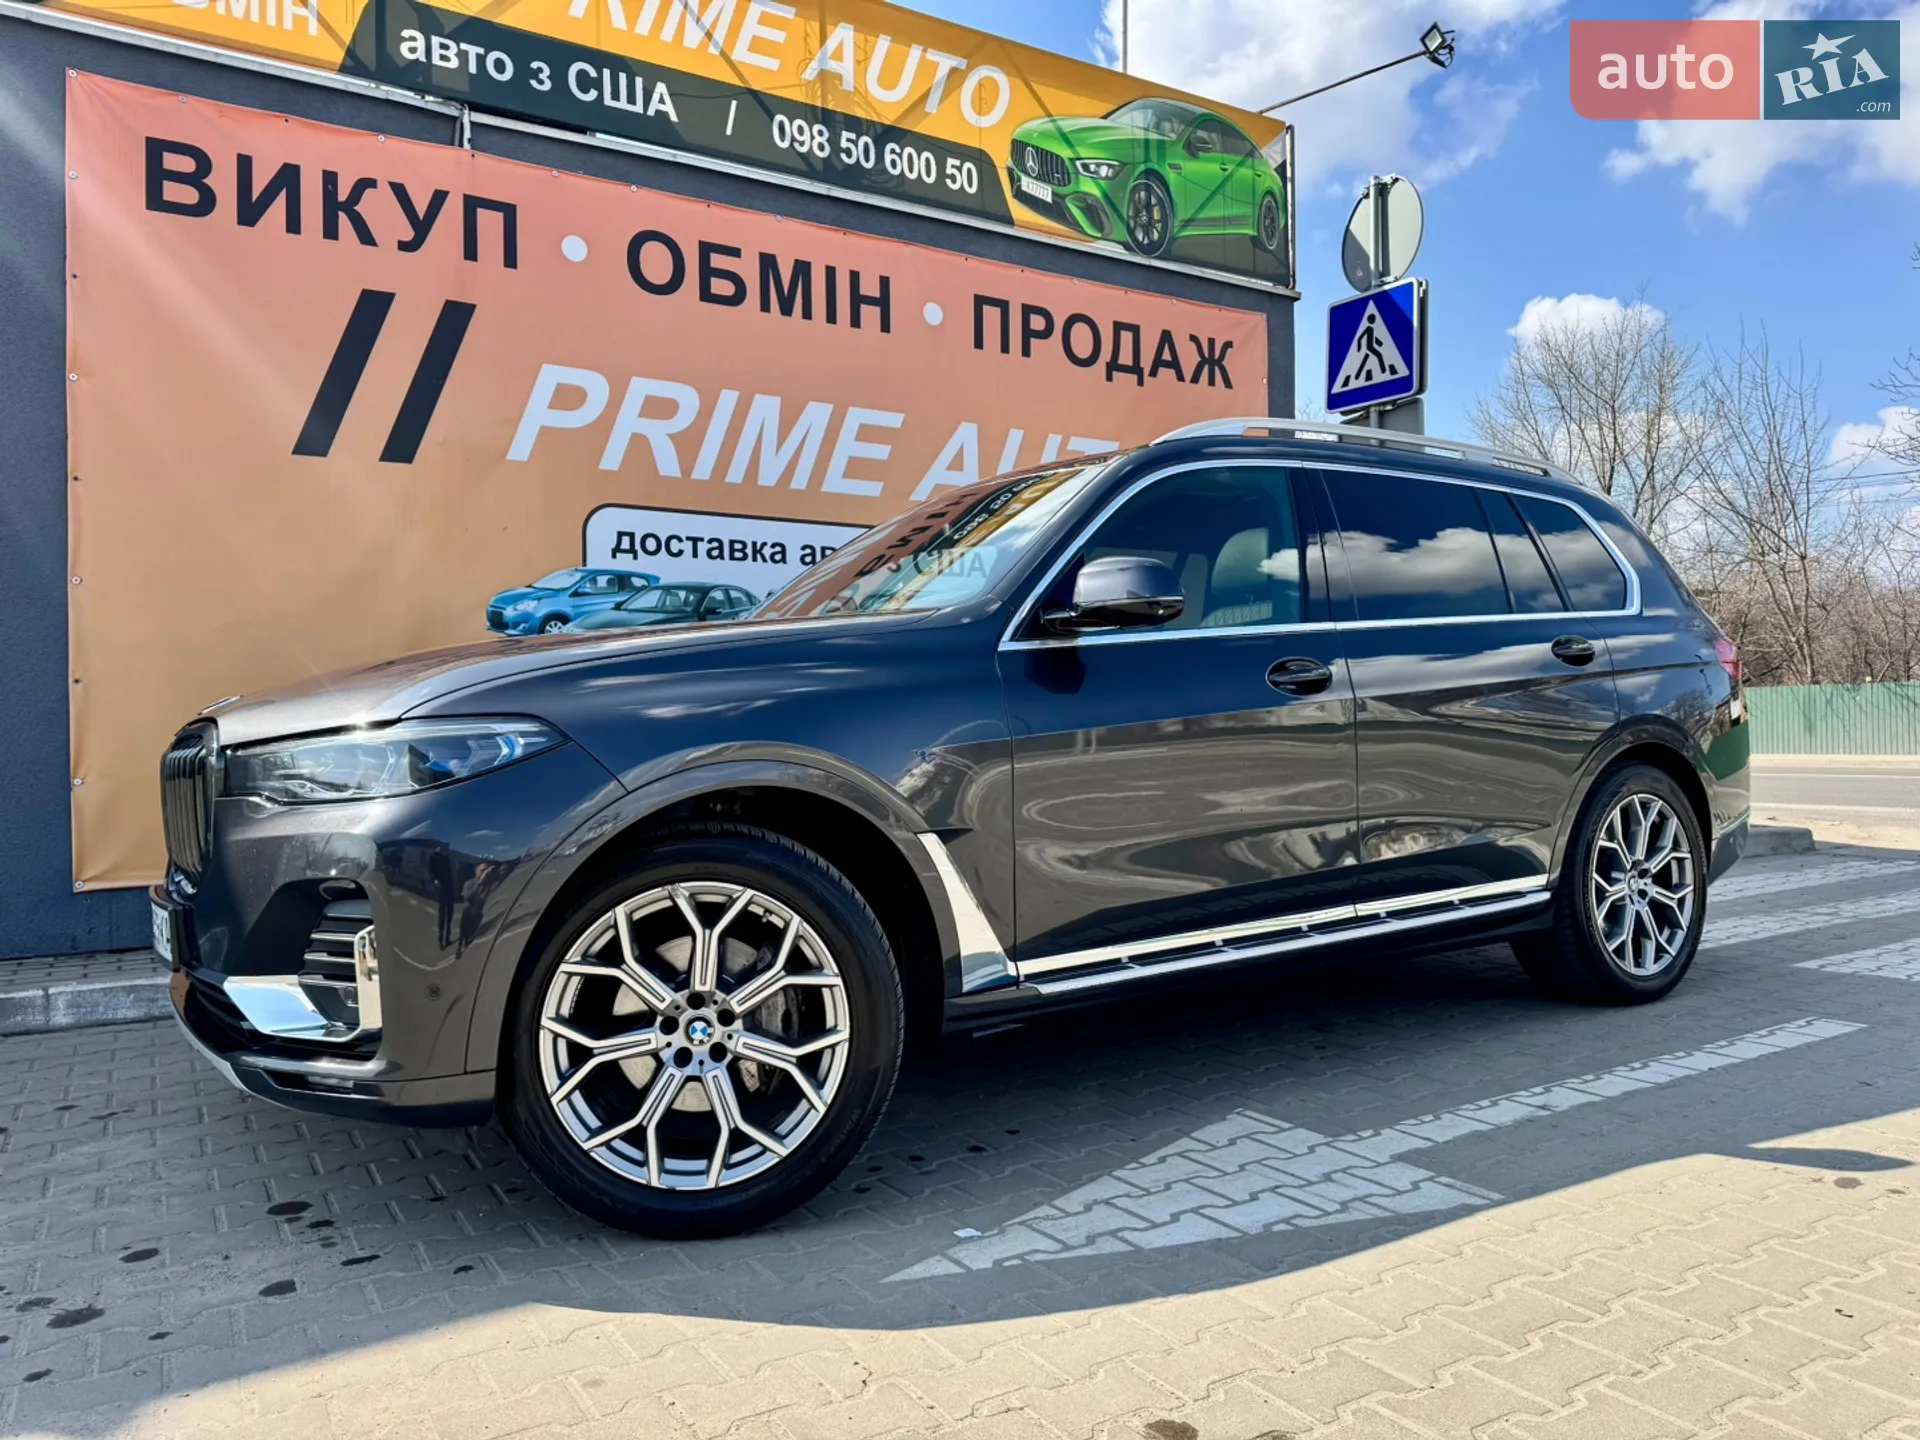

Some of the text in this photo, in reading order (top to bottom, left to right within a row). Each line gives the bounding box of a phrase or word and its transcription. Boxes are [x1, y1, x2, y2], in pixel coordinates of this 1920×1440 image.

[400, 28, 515, 82] авто
[567, 61, 679, 123] США
[772, 114, 831, 159] 098
[840, 130, 876, 170] 50
[884, 143, 937, 184] 600
[945, 158, 979, 195] 50
[802, 22, 1011, 129] AUTO
[144, 136, 1234, 390] ВИКУП ОБМІН ПРОДАЖ
[506, 363, 905, 498] PRIME
[611, 530, 787, 564] доставка
